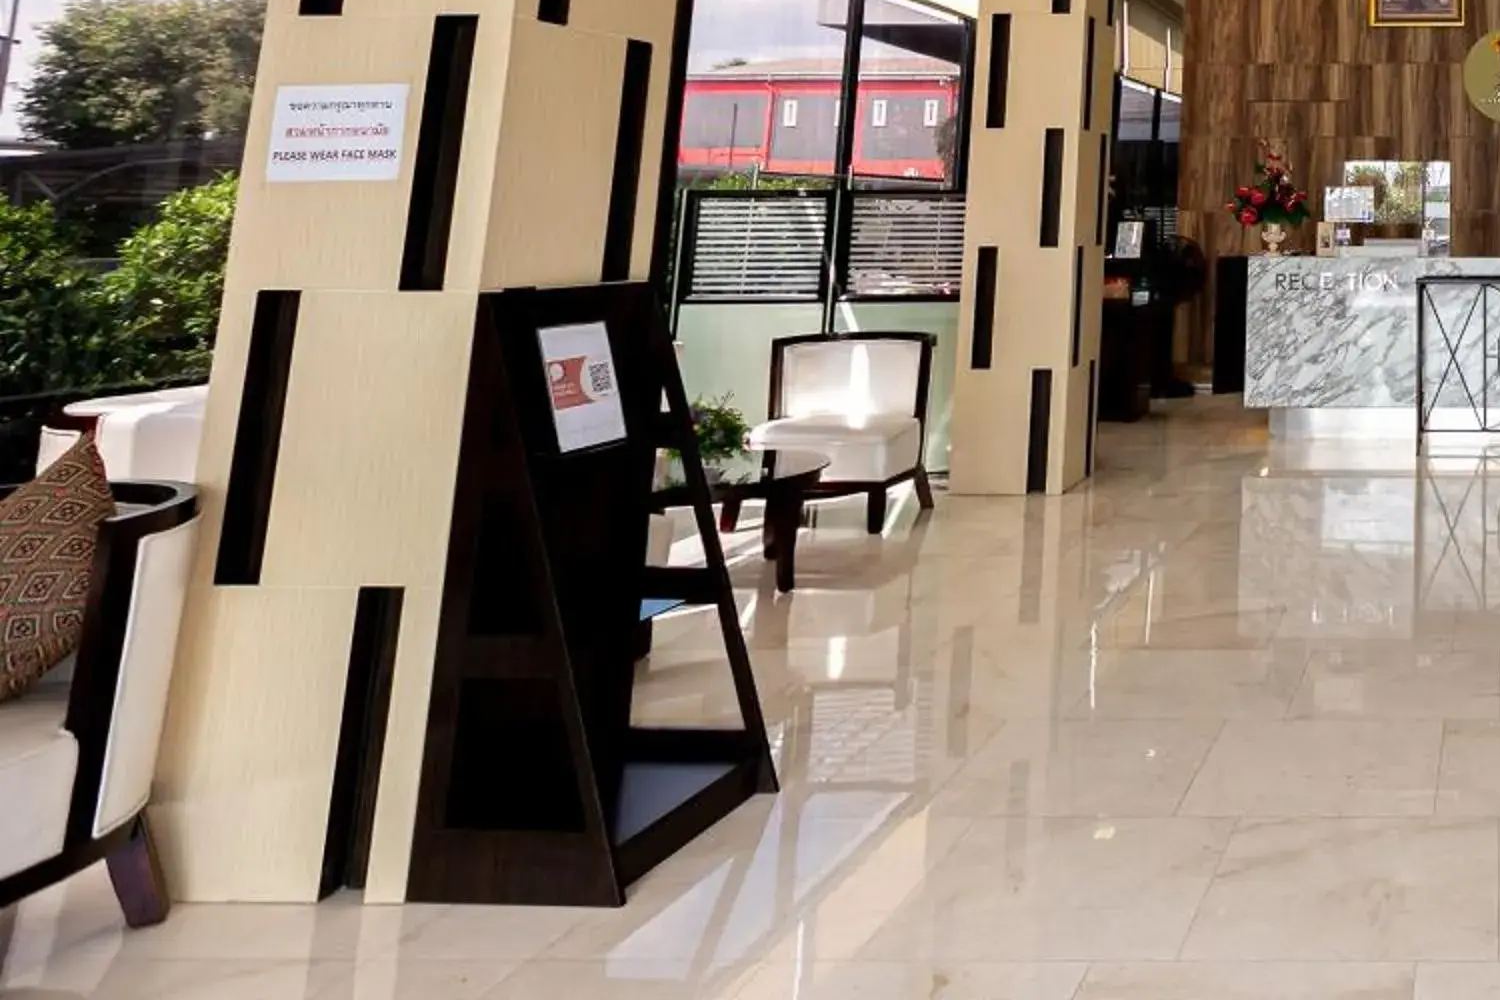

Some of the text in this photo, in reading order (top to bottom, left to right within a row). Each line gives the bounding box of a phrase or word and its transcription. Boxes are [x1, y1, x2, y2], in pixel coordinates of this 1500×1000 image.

[272, 149, 397, 161] PLEASE WEAR FACE MASK
[1275, 271, 1399, 291] RECETION
